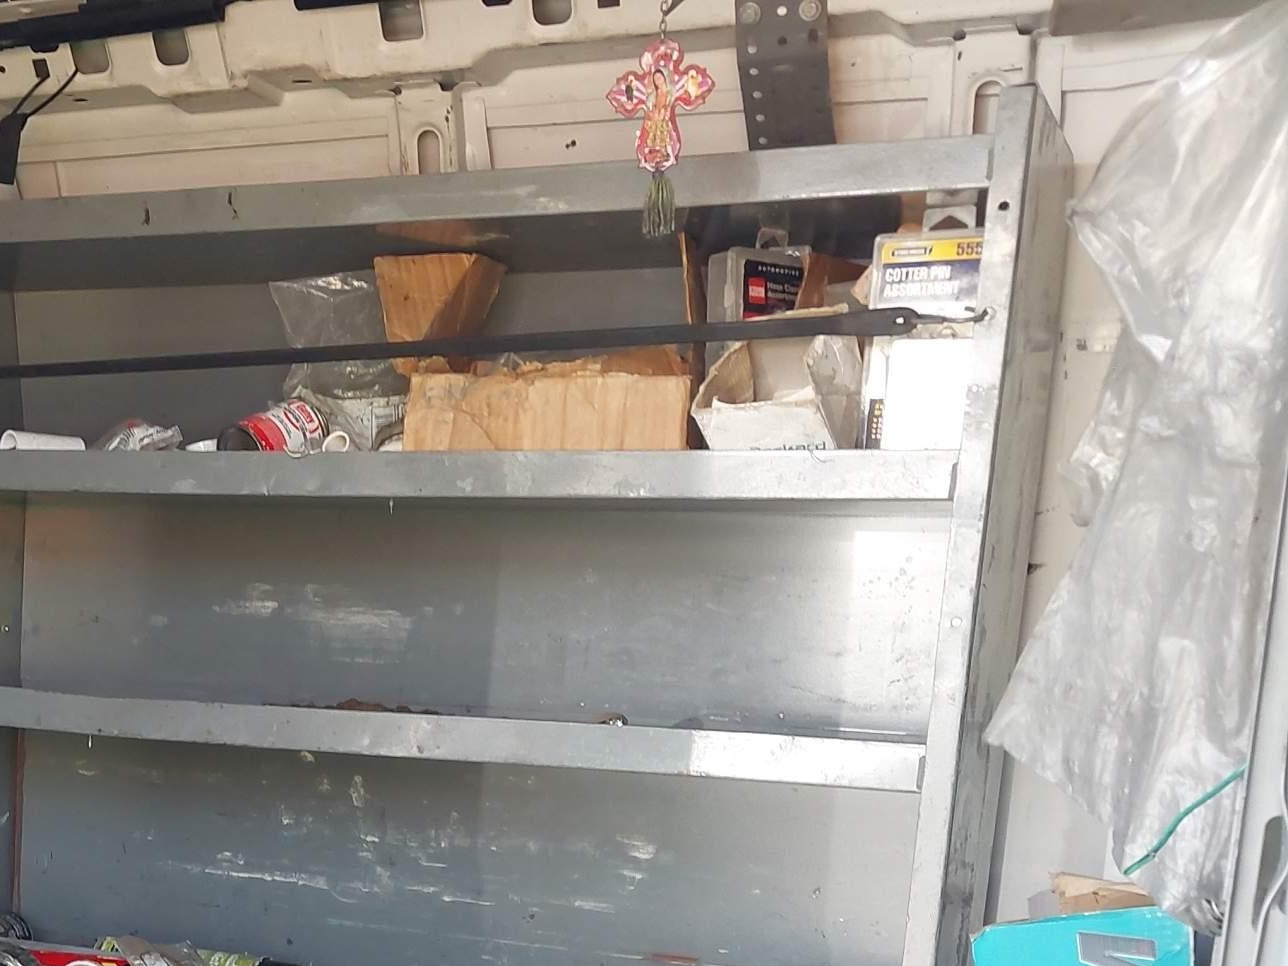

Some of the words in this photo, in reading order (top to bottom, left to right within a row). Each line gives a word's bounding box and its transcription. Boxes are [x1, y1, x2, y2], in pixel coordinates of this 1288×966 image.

[885, 266, 929, 283] COTTER
[930, 265, 952, 280] PIN
[884, 280, 961, 298] ASSORTMENT
